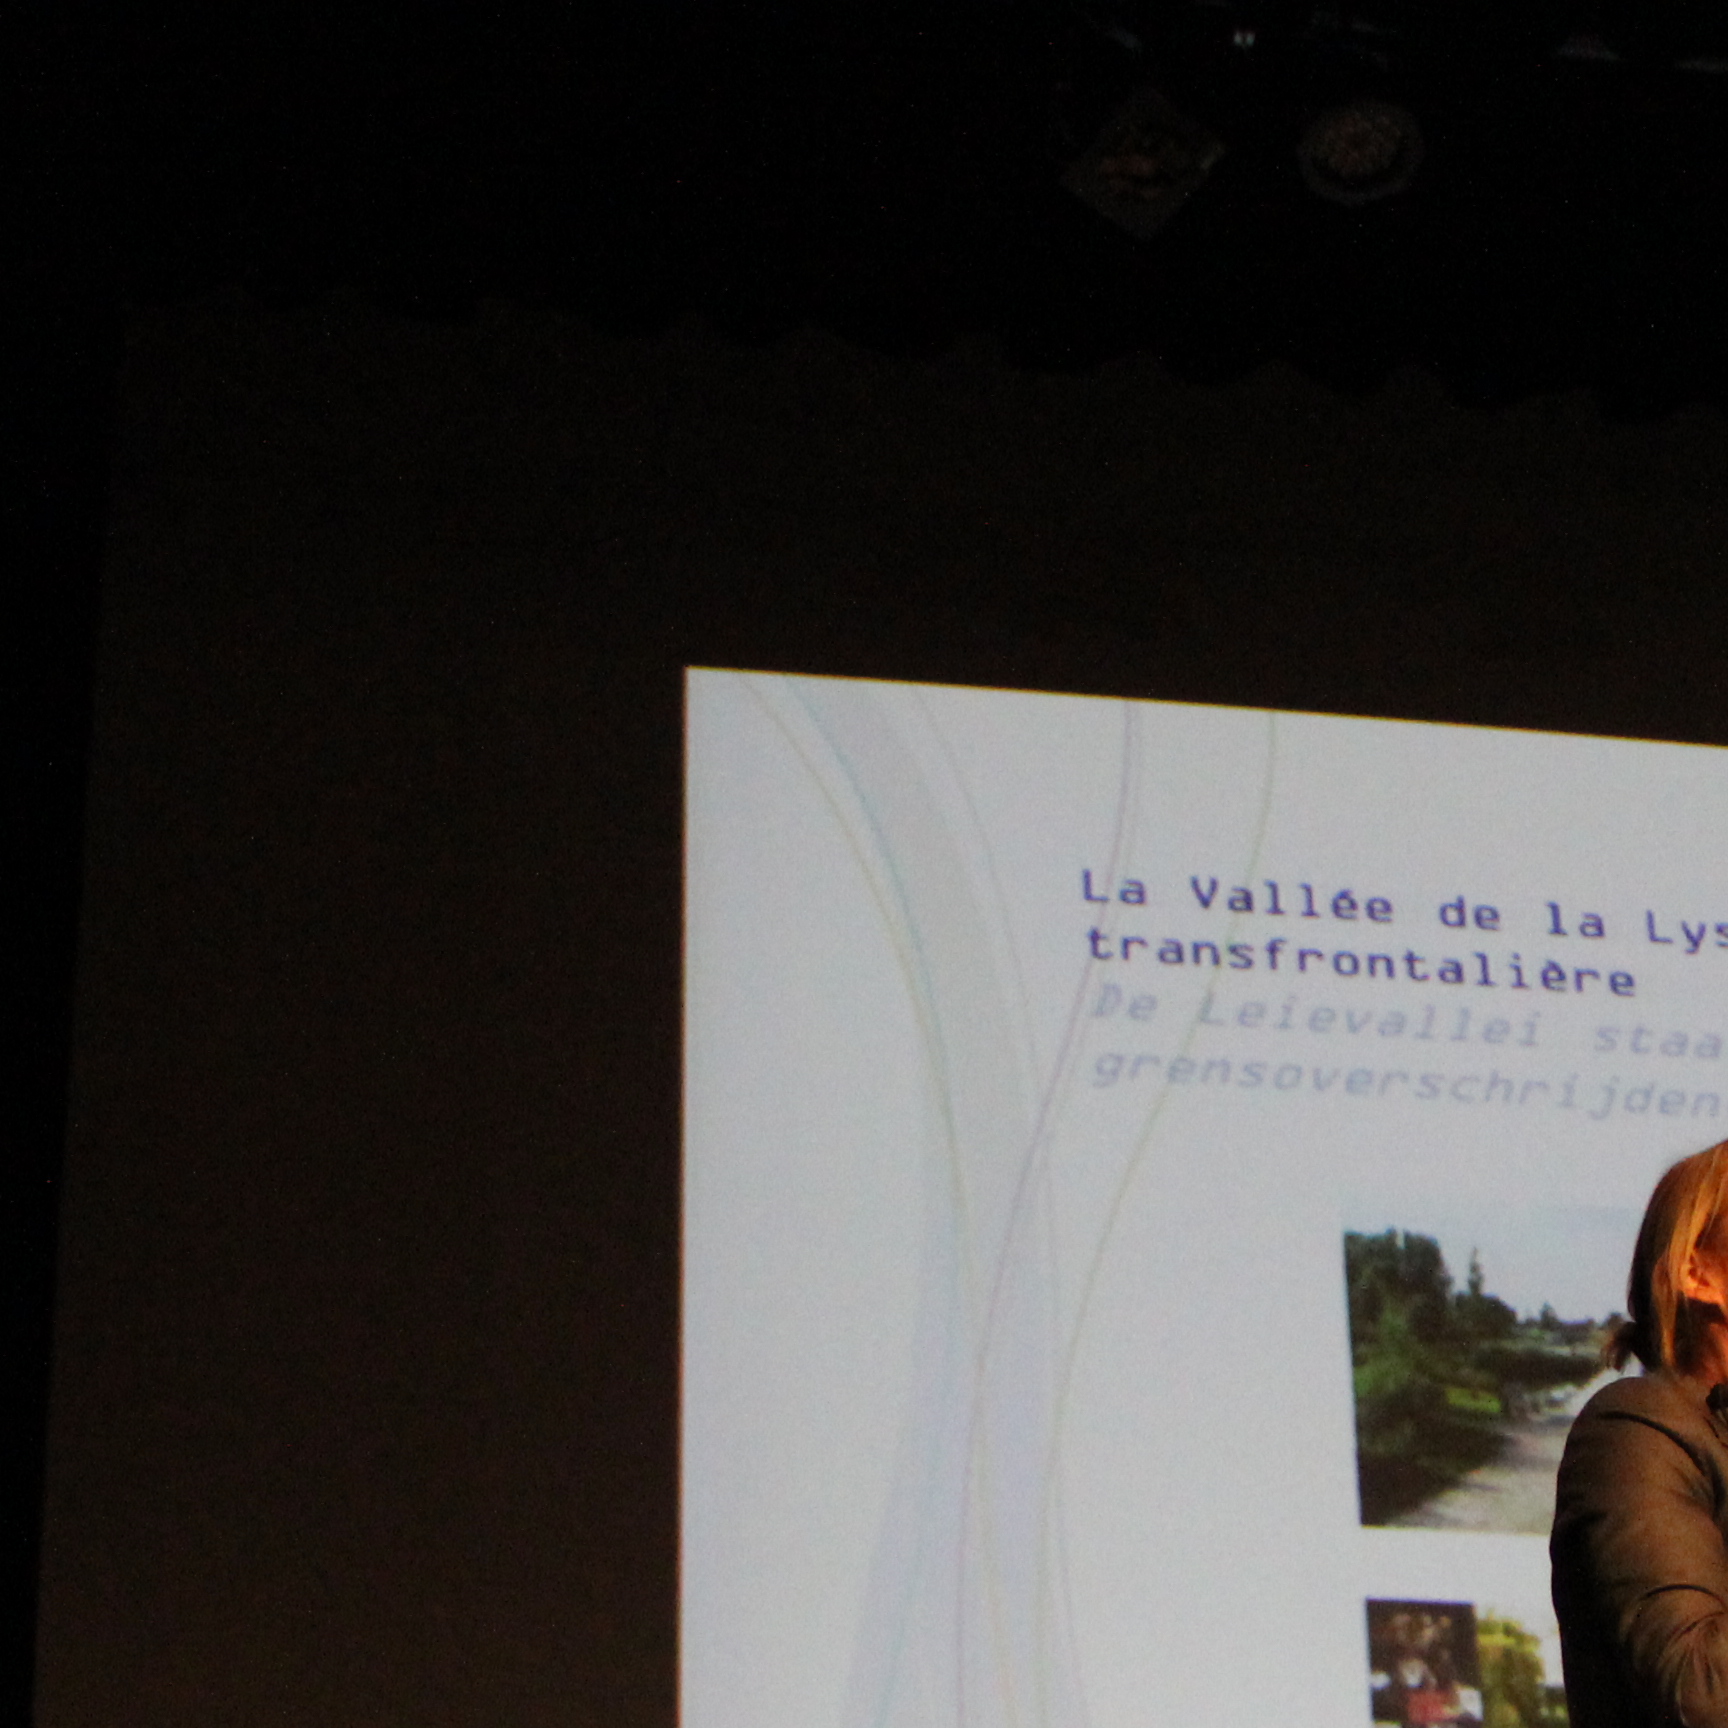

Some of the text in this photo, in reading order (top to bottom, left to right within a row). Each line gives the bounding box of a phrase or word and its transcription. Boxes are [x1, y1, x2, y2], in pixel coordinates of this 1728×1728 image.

[1083, 869, 1146, 907] La
[1190, 875, 1394, 923] Vallée
[1440, 896, 1501, 931] de
[1547, 901, 1606, 938] la
[1088, 928, 1637, 997] transfrontalière
[1093, 982, 1156, 1022] De
[1198, 991, 1540, 1047] Leievallei
